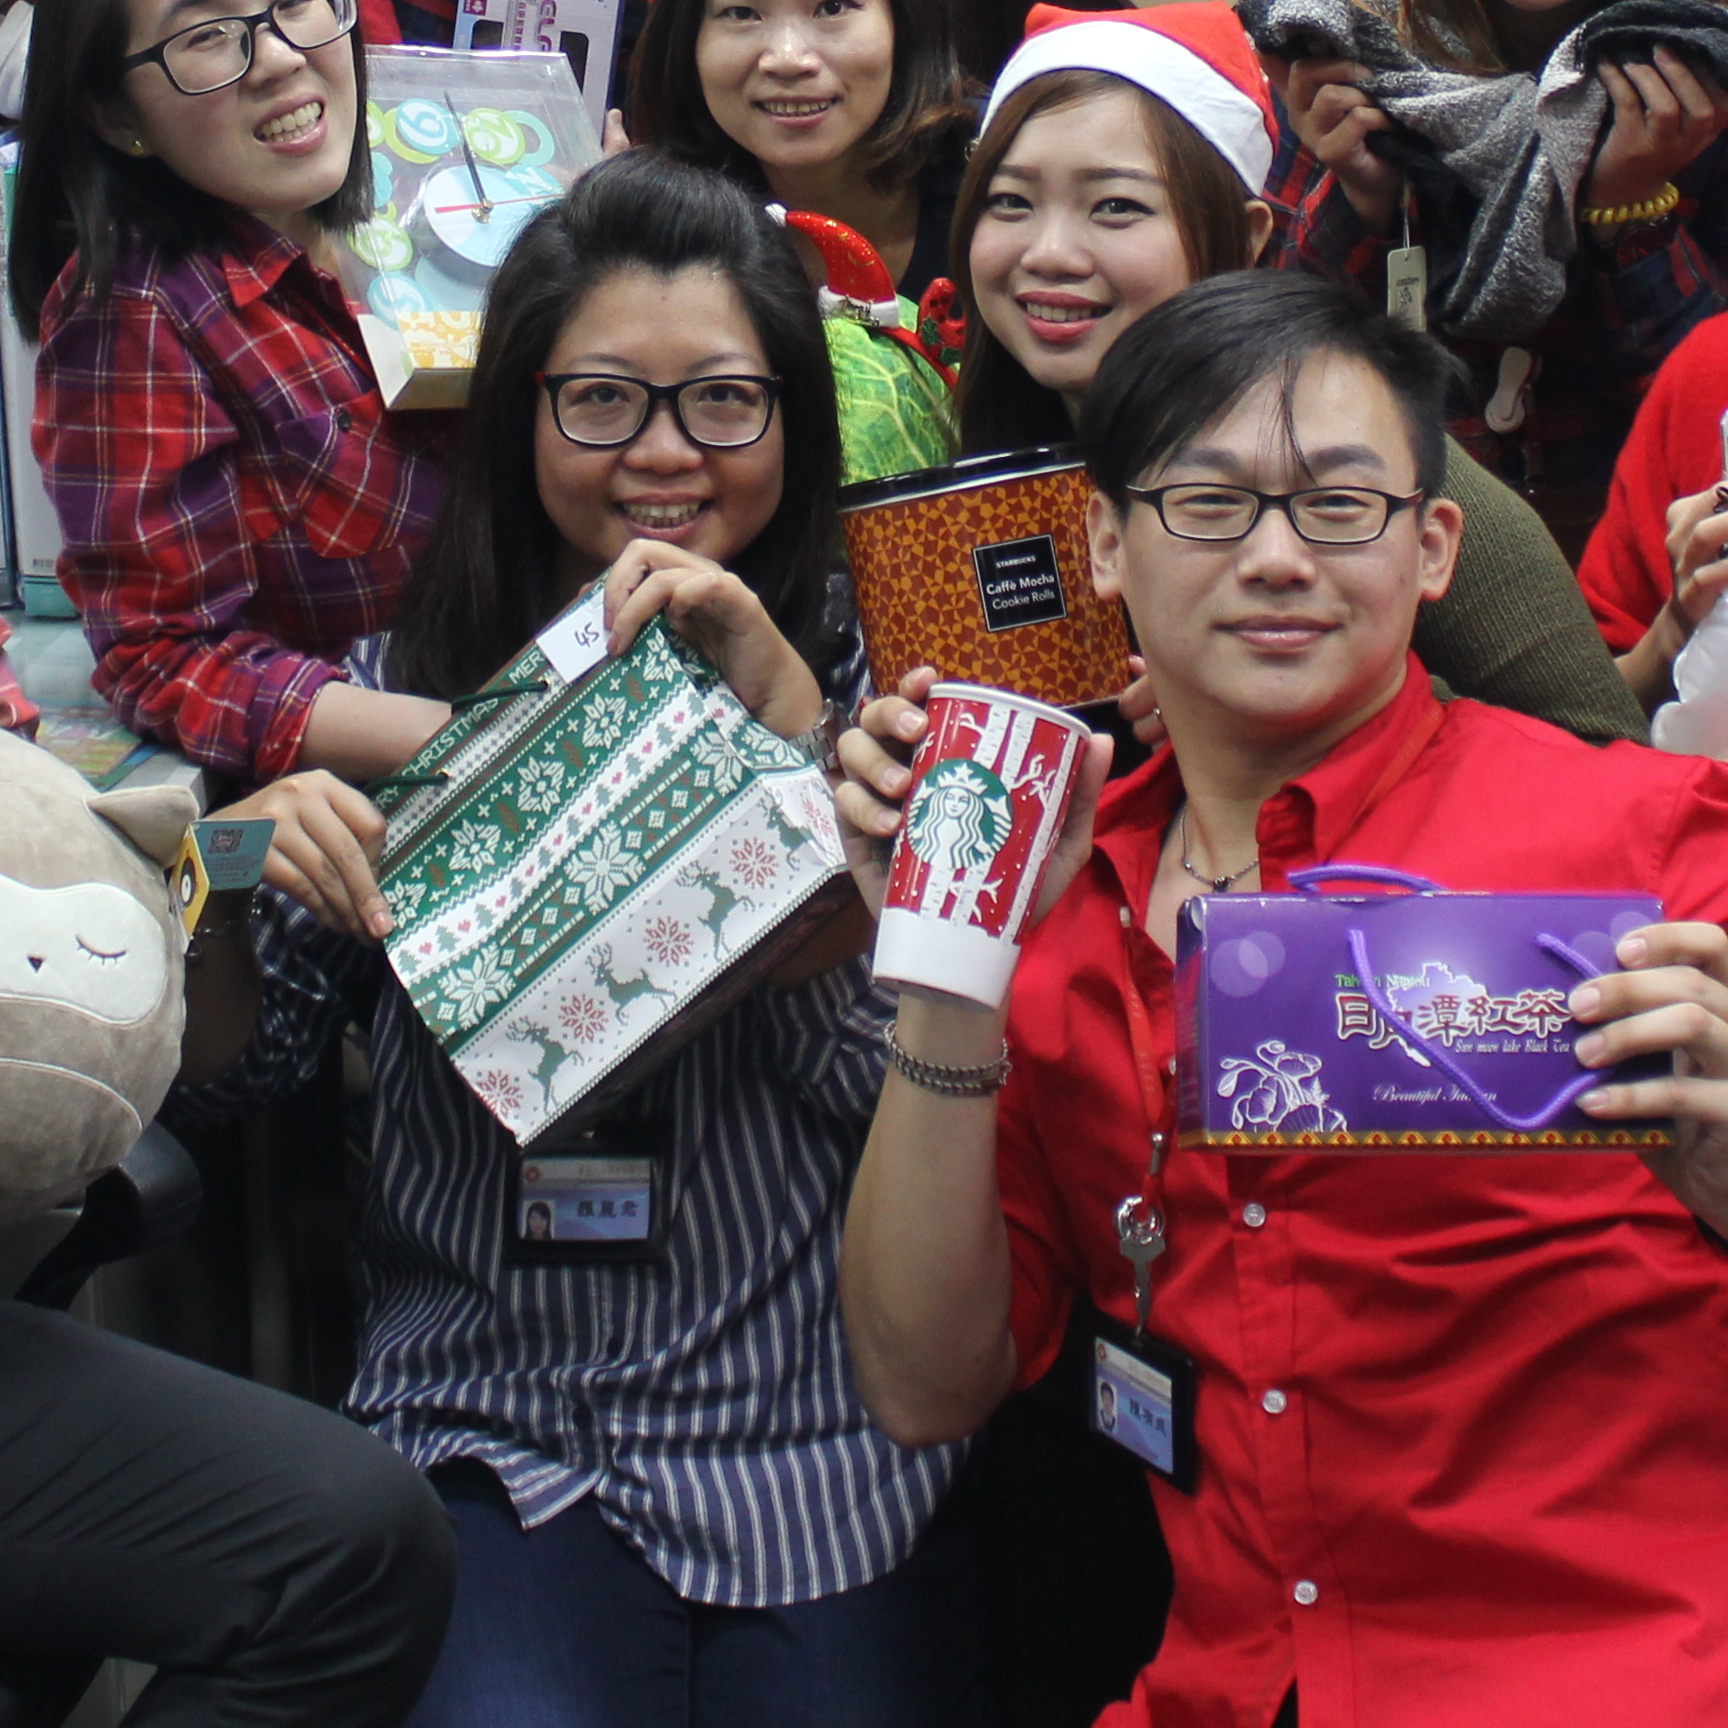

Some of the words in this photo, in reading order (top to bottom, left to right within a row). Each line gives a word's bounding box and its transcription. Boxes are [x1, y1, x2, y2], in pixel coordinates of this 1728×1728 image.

[995, 555, 1037, 569] STARBUCKS
[1018, 573, 1055, 589] Mocha
[992, 595, 1030, 610] Cookie
[1031, 588, 1056, 603] Rolls
[573, 621, 600, 649] 45
[508, 649, 545, 685] MER
[401, 697, 500, 777] CHRISTMAS
[1502, 1039, 1522, 1054] lake
[1524, 1039, 1548, 1054] Black
[1372, 1084, 1442, 1105] Beautiful
